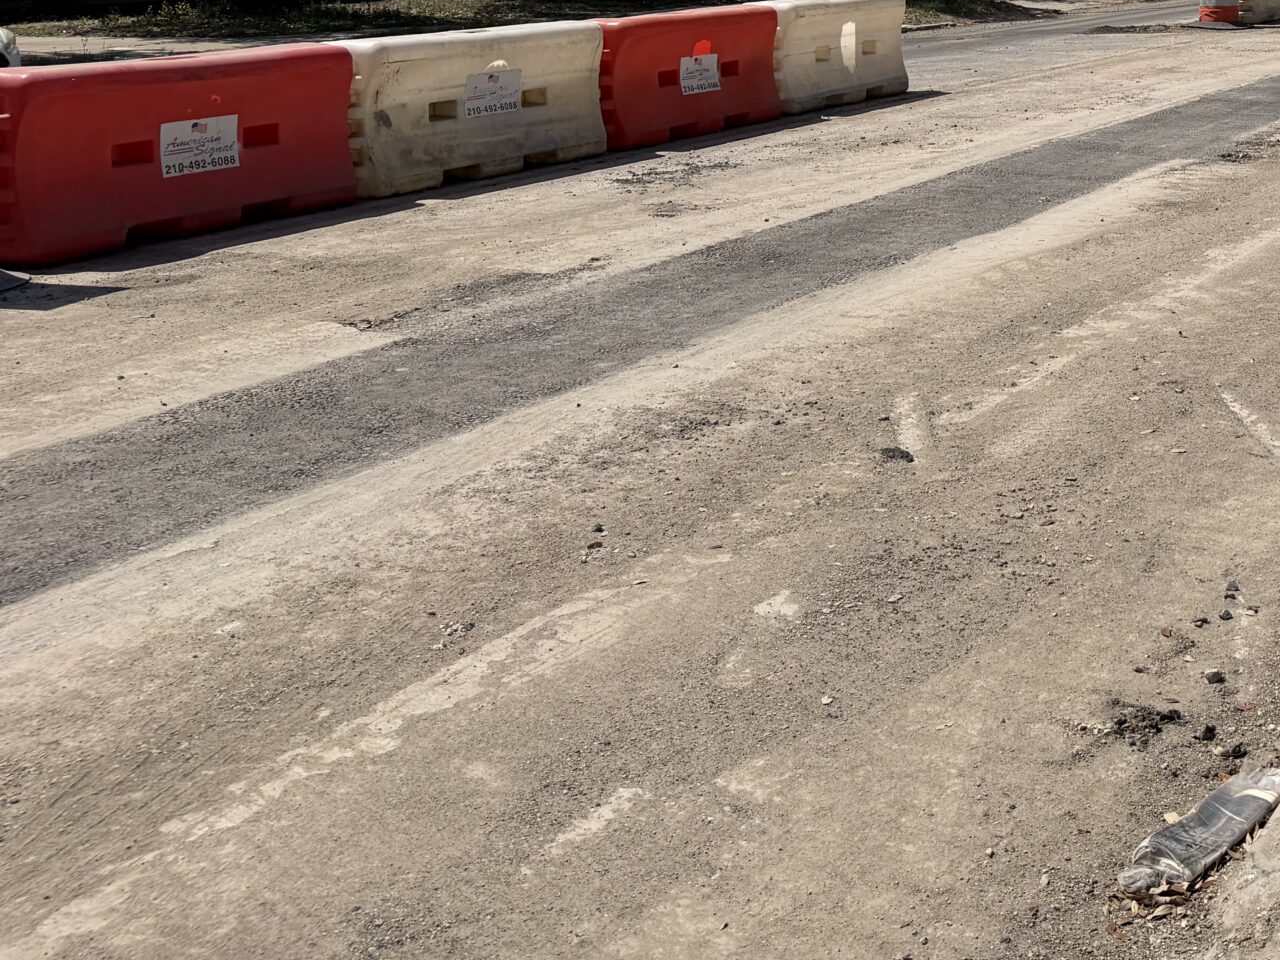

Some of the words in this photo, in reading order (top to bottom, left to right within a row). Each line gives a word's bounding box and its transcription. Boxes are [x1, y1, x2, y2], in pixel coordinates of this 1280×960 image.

[466, 101, 518, 116] 210-492-6088
[164, 136, 222, 150] American
[193, 141, 236, 158] Signal
[164, 155, 236, 175] 210-492-6088
